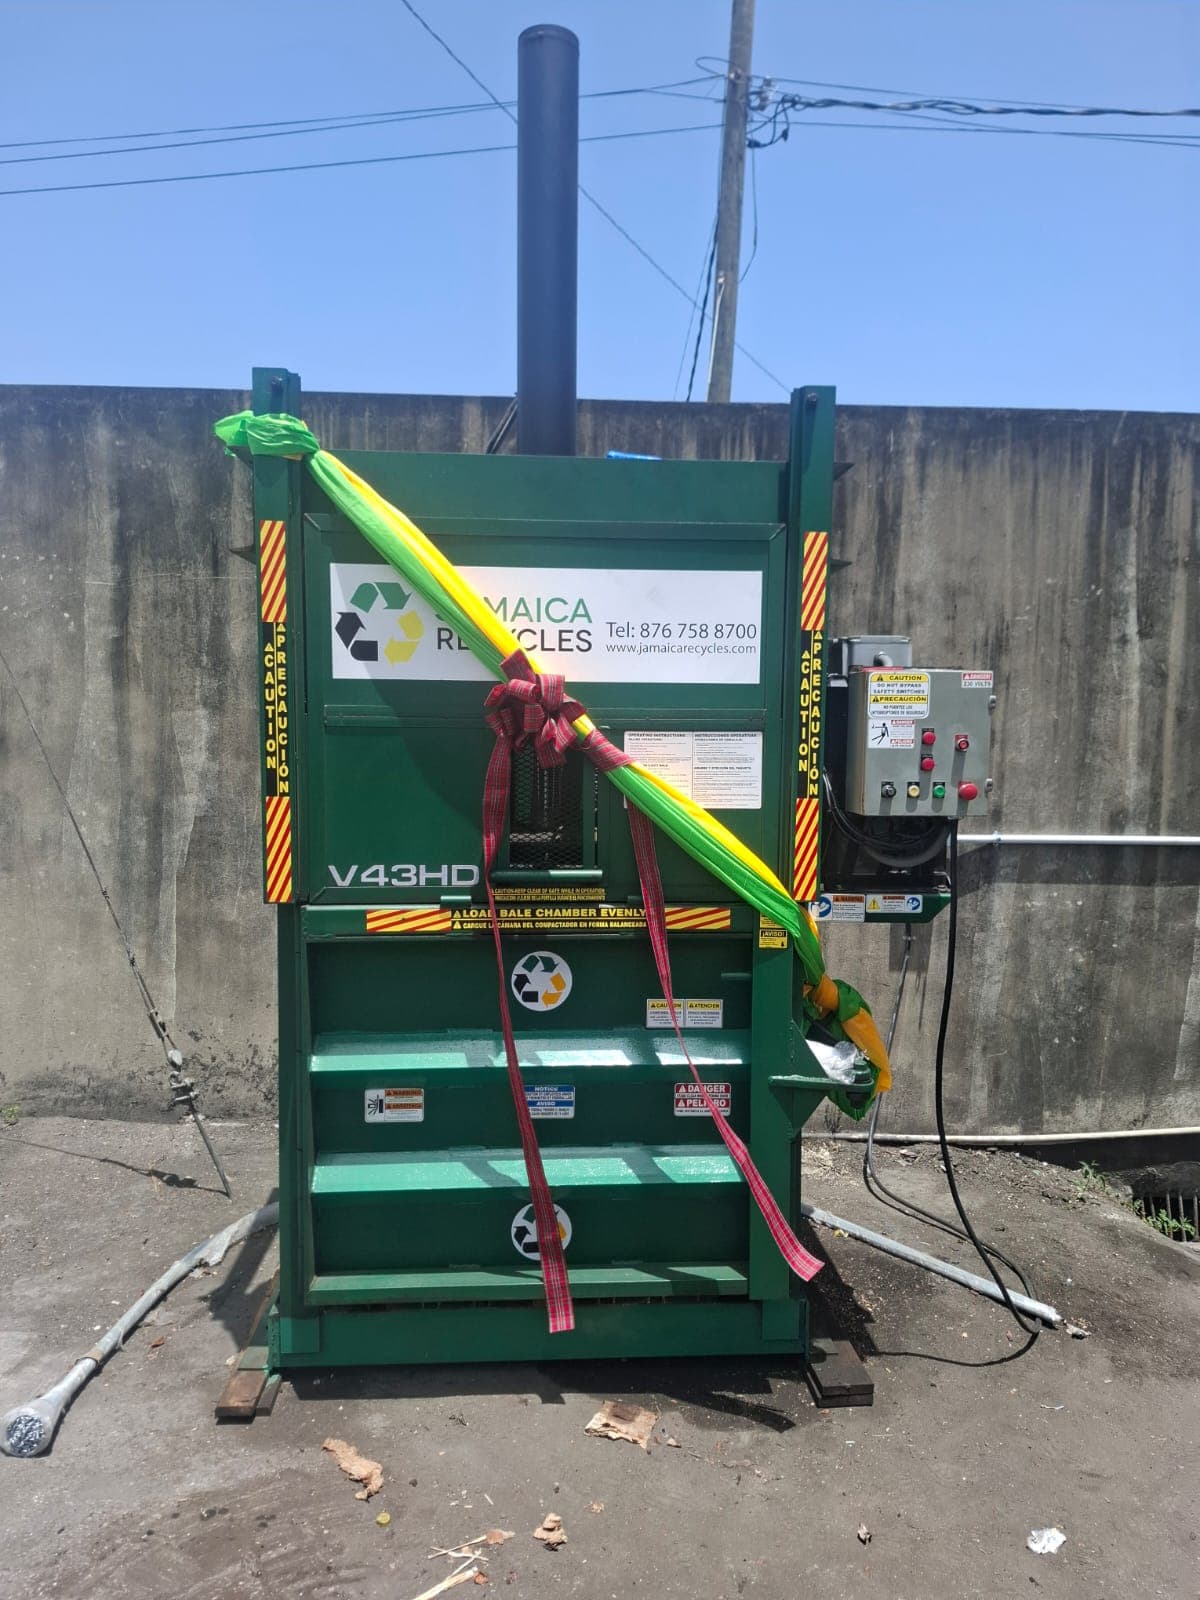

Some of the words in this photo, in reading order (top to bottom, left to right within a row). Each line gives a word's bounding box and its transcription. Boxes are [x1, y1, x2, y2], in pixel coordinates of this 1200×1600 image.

[435, 596, 593, 624] MAICA
[437, 627, 593, 653] RCLES
[606, 621, 635, 638] Tel:
[640, 622, 672, 638] 876
[677, 623, 709, 639] 758
[714, 623, 757, 639] 8700
[606, 642, 757, 657] www.jamaicarecycles.com
[264, 654, 276, 769] CAUTION
[276, 635, 289, 793] PRECAUCIÓN
[798, 661, 810, 772] CAUTION
[809, 642, 823, 796] PRECAUCIÓN
[328, 864, 480, 887] V43HD
[500, 909, 532, 918] BALE
[535, 908, 597, 918] CHAMBER
[600, 908, 646, 917] EVENLY
[535, 921, 578, 929] COMPACTADOR
[688, 1084, 726, 1092] DAGER
[686, 1099, 726, 1107] PELIRO
